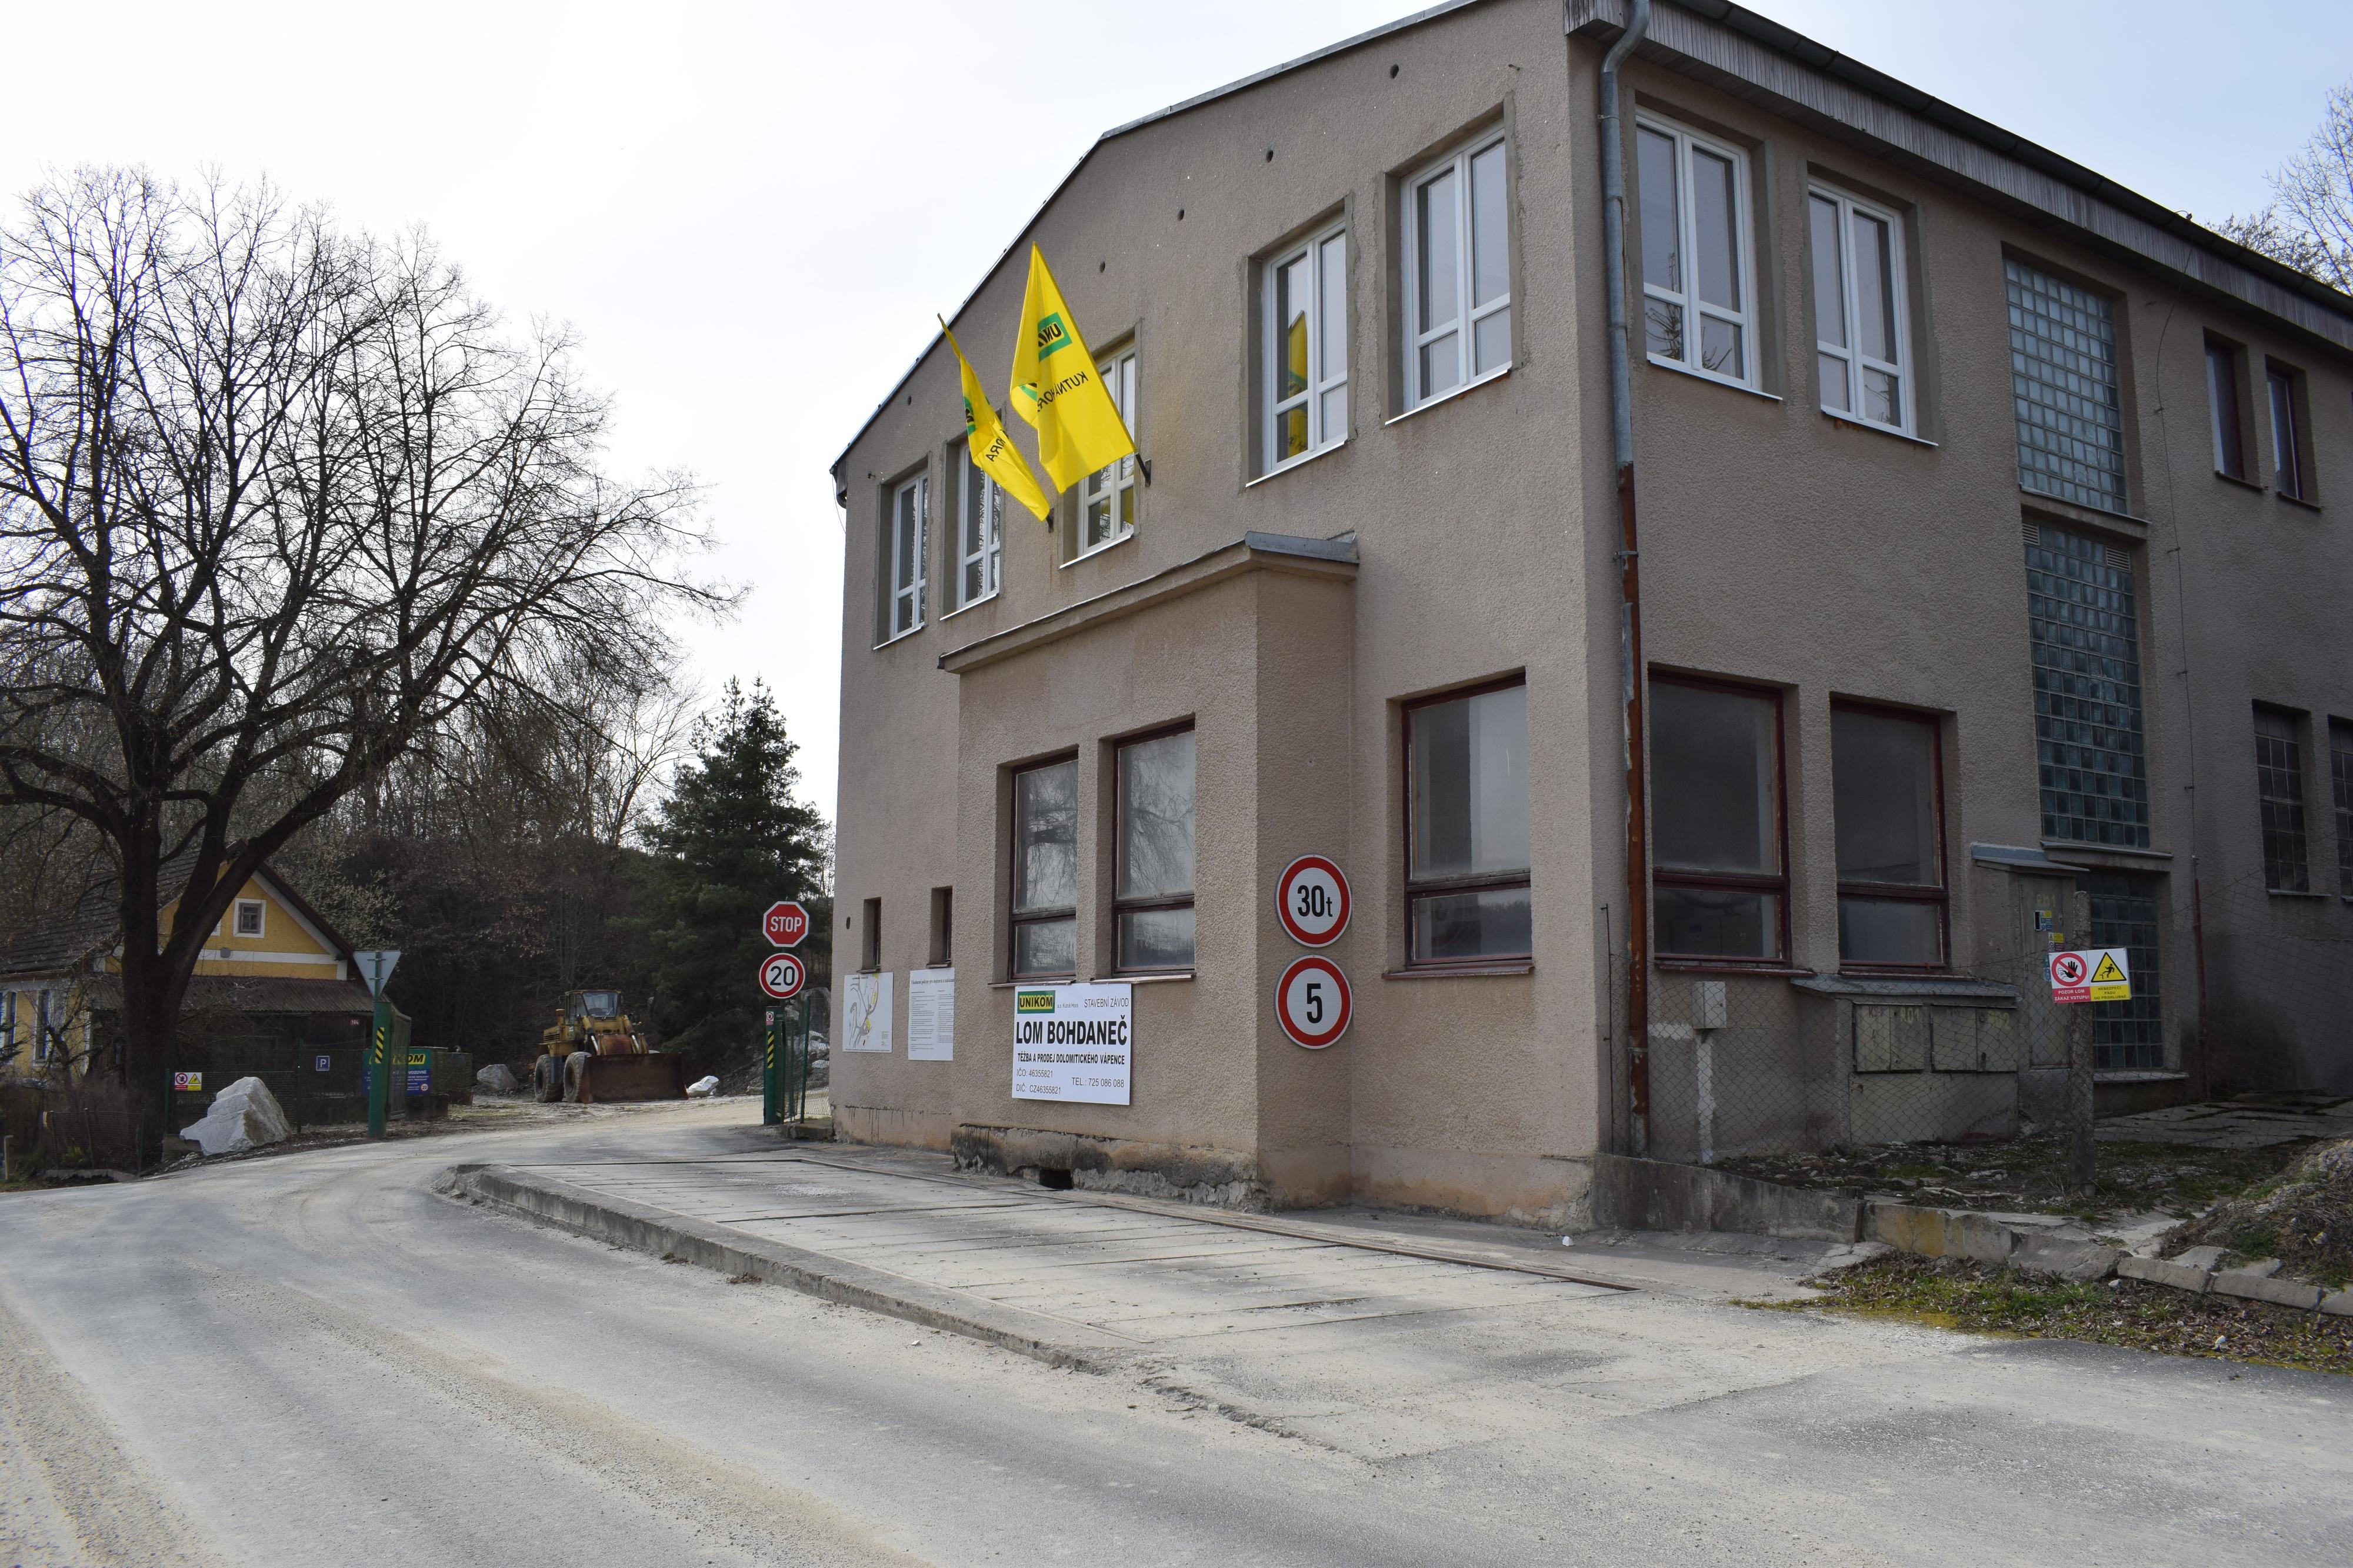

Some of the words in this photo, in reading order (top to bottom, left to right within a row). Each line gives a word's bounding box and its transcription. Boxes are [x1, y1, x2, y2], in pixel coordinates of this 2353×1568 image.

[770, 916, 802, 932] STOP
[769, 965, 796, 986] 20
[1019, 996, 1052, 1007] UNIKOM
[1084, 996, 1109, 1007] STAVEBNÍ
[1110, 996, 1129, 1007] ZÁVOD
[1306, 983, 1323, 1024] 5
[1016, 1021, 1043, 1044] LOM
[1047, 1015, 1127, 1045] BOHDANEČ
[320, 1059, 326, 1067] P
[1018, 1051, 1032, 1062] TĚŽBA
[1033, 1053, 1036, 1062] A
[1037, 1053, 1055, 1063] PRODEJ
[1056, 1052, 1098, 1063] DOLOMITICKÉHO
[1100, 1052, 1125, 1065] VÁPENCE
[1029, 1070, 1053, 1078] 46355821
[1072, 1077, 1086, 1086] TEL.:
[1088, 1078, 1099, 1087] 725
[1101, 1079, 1111, 1087] 086
[1113, 1079, 1124, 1088] 088
[1029, 1085, 1061, 1095] CZ46355821
